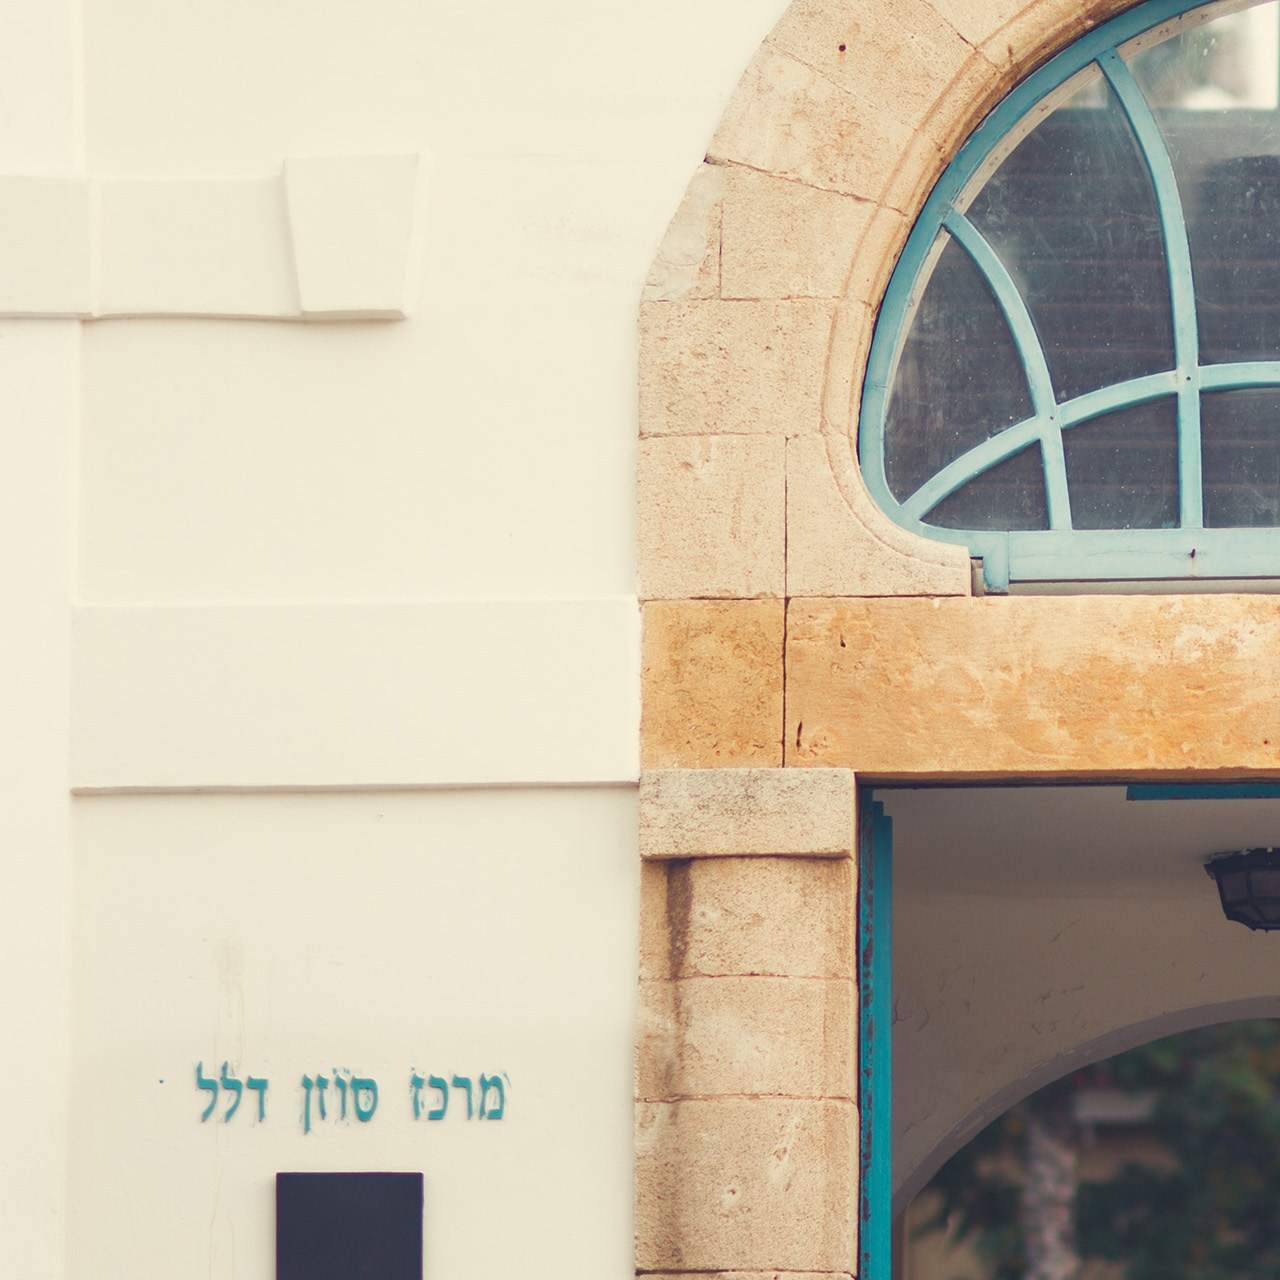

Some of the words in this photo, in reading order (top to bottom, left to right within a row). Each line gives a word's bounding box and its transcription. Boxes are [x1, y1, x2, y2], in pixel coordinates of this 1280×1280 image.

[196, 1061, 269, 1121] דלל
[302, 1075, 379, 1134] סוזן
[411, 1074, 506, 1120] מרכז
